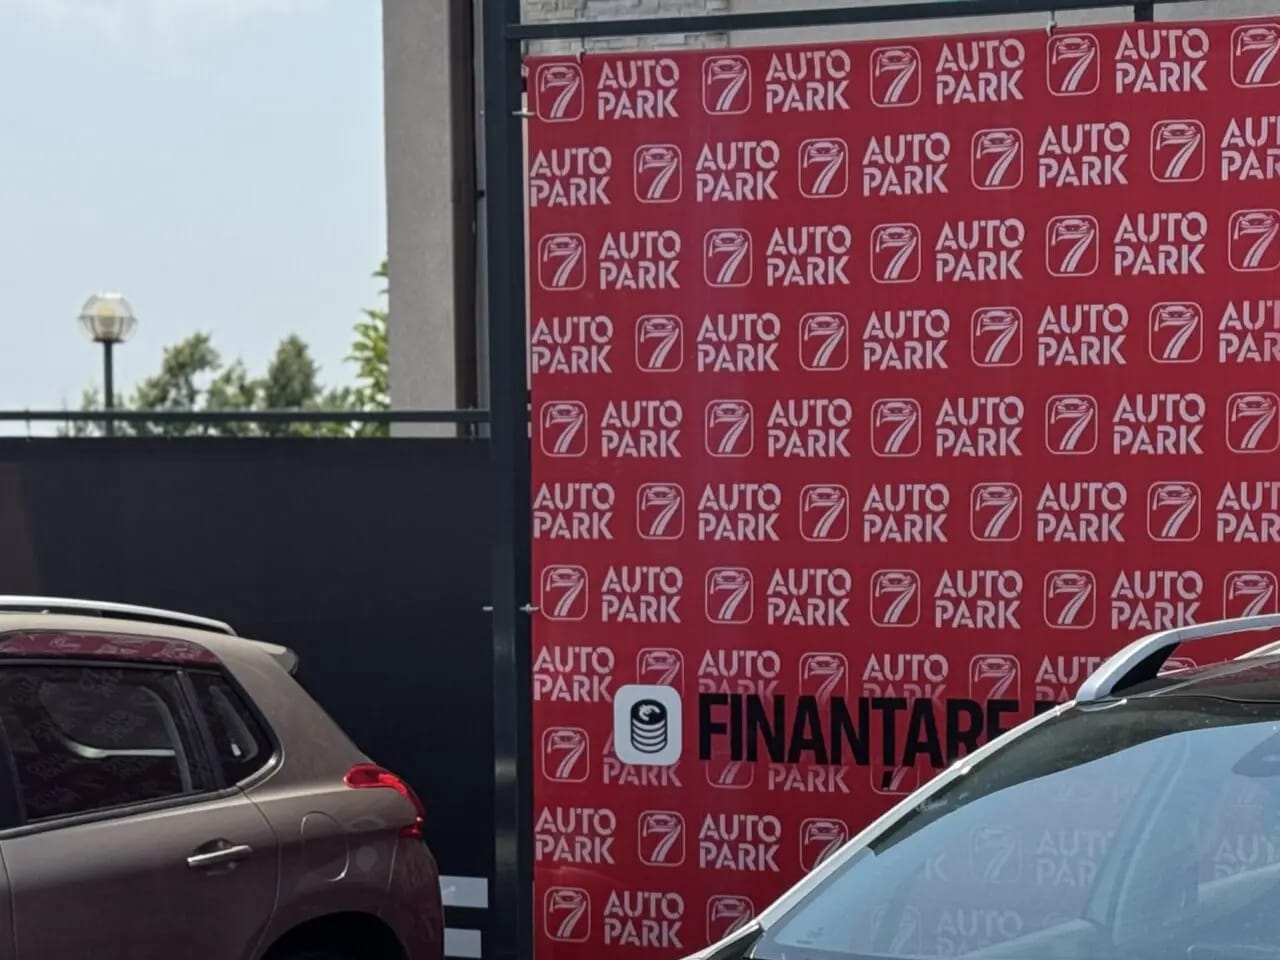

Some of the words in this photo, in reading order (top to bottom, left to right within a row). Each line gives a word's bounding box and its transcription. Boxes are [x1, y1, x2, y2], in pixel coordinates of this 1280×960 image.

[937, 39, 1026, 75] AUTO
[1116, 29, 1210, 62] AUTO
[598, 59, 681, 91] AUTO
[766, 50, 852, 83] AUTO
[1117, 61, 1209, 95] PARK
[767, 81, 851, 114] PARK
[937, 69, 1024, 106] PARK
[599, 88, 680, 121] PARK
[863, 133, 951, 167] AUTO
[1039, 122, 1131, 157] AUTO
[531, 147, 613, 179] AUTO
[694, 140, 781, 174] AUTO
[1040, 155, 1129, 189] PARK
[531, 176, 611, 209] PARK
[696, 170, 779, 204] PARK
[864, 163, 949, 198] PARK
[767, 226, 853, 257] AUTO
[936, 219, 1026, 252] AUTO
[1115, 212, 1209, 245] AUTO
[599, 230, 682, 261] AUTO
[1116, 244, 1206, 277] PARK
[601, 260, 681, 291] PARK
[768, 256, 851, 287] PARK
[937, 249, 1023, 283] PARK
[532, 316, 614, 345] AUTO
[697, 313, 781, 344] AUTO
[863, 310, 951, 341] AUTO
[1038, 304, 1129, 336] AUTO
[533, 344, 613, 375] PARK
[698, 343, 780, 374] PARK
[864, 340, 949, 372] PARK
[1039, 334, 1127, 367] PARK
[601, 400, 684, 430] AUTO
[768, 399, 853, 429] AUTO
[937, 397, 1025, 427] AUTO
[1114, 394, 1206, 425] AUTO
[602, 430, 682, 459] PARK
[769, 429, 851, 458] PARK
[937, 426, 1023, 458] PARK
[1114, 424, 1204, 455] PARK
[534, 483, 616, 512] AUTO
[699, 484, 782, 514] AUTO
[864, 484, 951, 513] AUTO
[1037, 483, 1128, 512] AUTO
[535, 511, 614, 541] PARK
[699, 513, 780, 542] PARK
[865, 514, 948, 544] PARK
[1038, 513, 1125, 543] PARK
[602, 567, 684, 595] AUTO
[767, 569, 853, 598] AUTO
[935, 571, 1024, 600] AUTO
[1112, 571, 1204, 601] AUTO
[603, 595, 681, 624] PARK
[769, 598, 850, 627] PARK
[936, 600, 1021, 630] PARK
[1112, 601, 1206, 632] PARK
[534, 647, 615, 675] AUTO
[699, 650, 781, 679] AUTO
[864, 655, 949, 683] AUTO
[534, 674, 616, 705] PARK
[768, 764, 850, 793] PARK
[536, 808, 617, 836] AUTO
[699, 815, 782, 843] AUTO
[537, 835, 615, 865] PARK
[701, 843, 780, 872] PARK
[605, 892, 685, 920] AUTO
[606, 919, 683, 949] PARK
